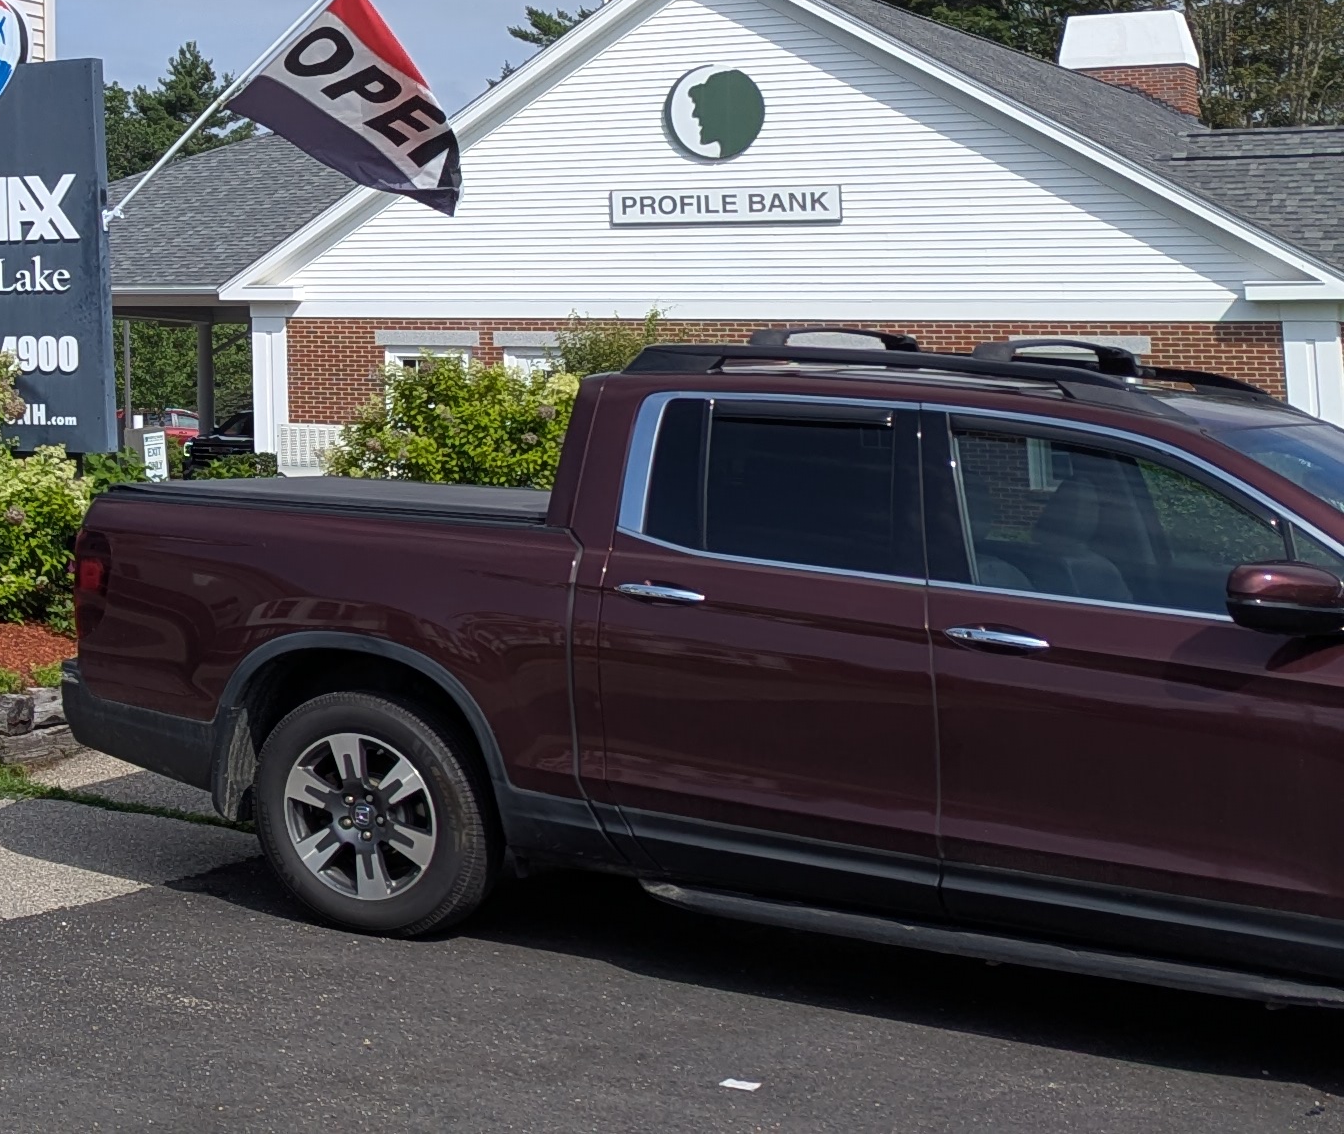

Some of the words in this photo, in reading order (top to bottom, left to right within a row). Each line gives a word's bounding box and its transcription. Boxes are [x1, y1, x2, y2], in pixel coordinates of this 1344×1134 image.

[621, 194, 739, 215] PROFILE
[748, 191, 830, 213] BANK
[147, 446, 161, 457] EXIT
